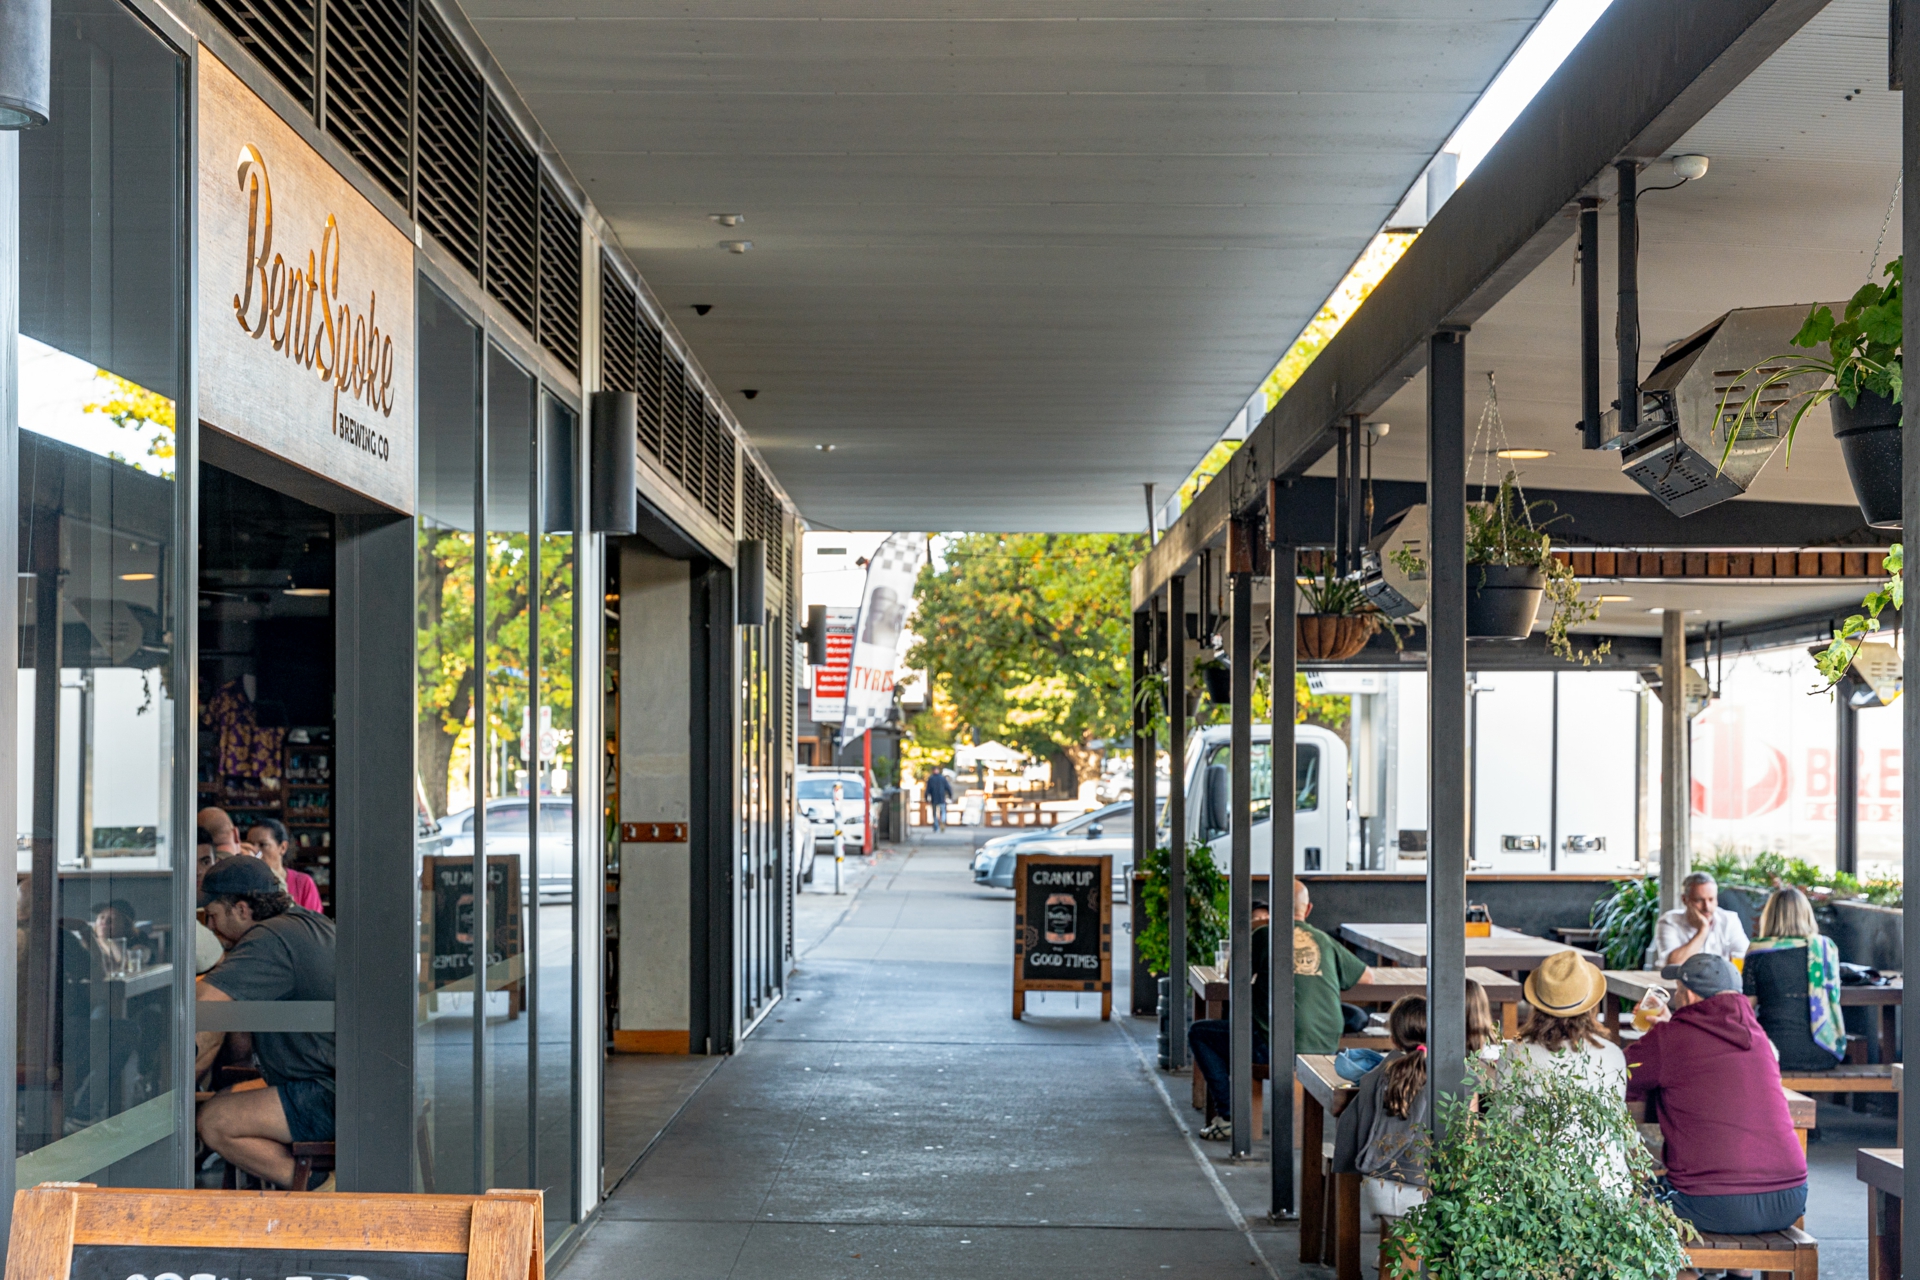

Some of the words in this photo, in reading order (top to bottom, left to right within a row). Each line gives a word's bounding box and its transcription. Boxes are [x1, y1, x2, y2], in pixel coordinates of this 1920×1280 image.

[233, 143, 395, 435] BentSpoke
[339, 412, 377, 456] BREWING
[378, 434, 389, 462] CO
[1807, 803, 1901, 821] FODS
[1032, 871, 1075, 886] CRANK
[1076, 871, 1094, 886] UP
[1030, 952, 1063, 967] GOOD
[1063, 953, 1099, 969] TIMES
